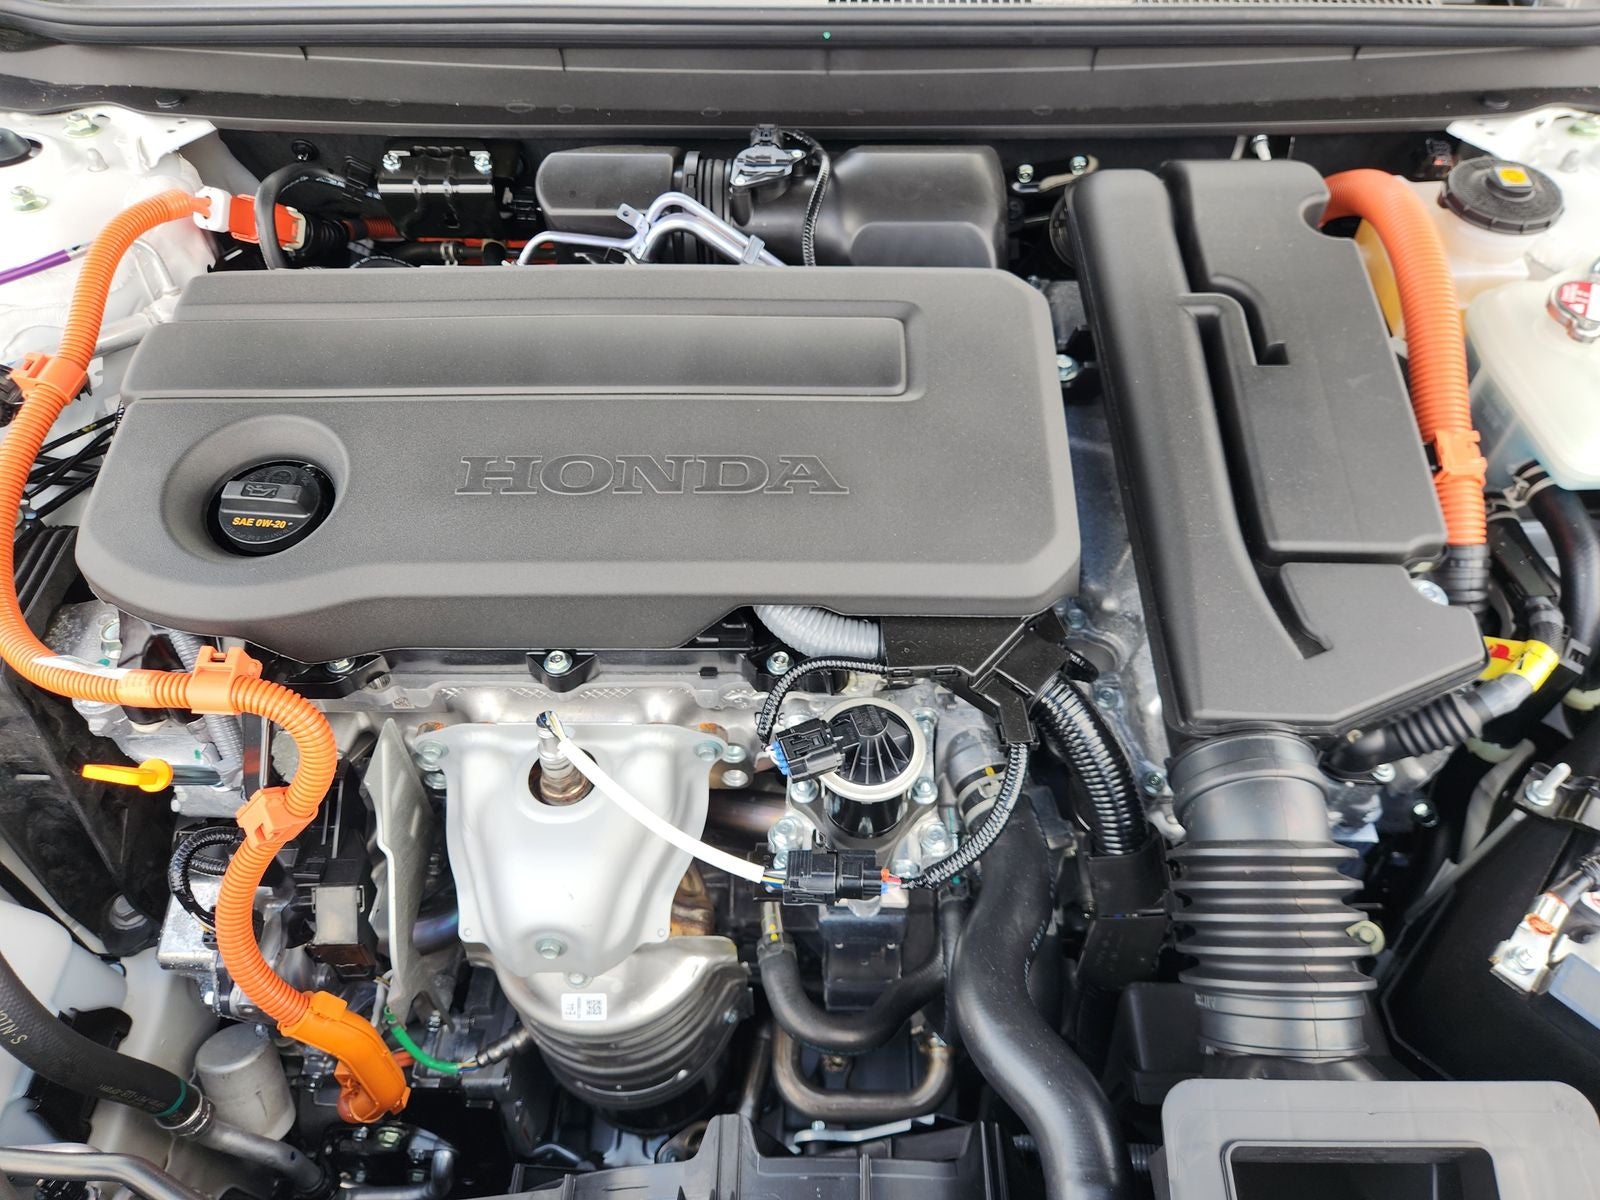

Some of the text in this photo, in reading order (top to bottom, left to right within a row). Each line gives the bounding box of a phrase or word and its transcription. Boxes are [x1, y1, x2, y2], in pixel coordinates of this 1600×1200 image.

[454, 453, 850, 495] HONDA
[232, 516, 287, 529] SAE 0W-20
